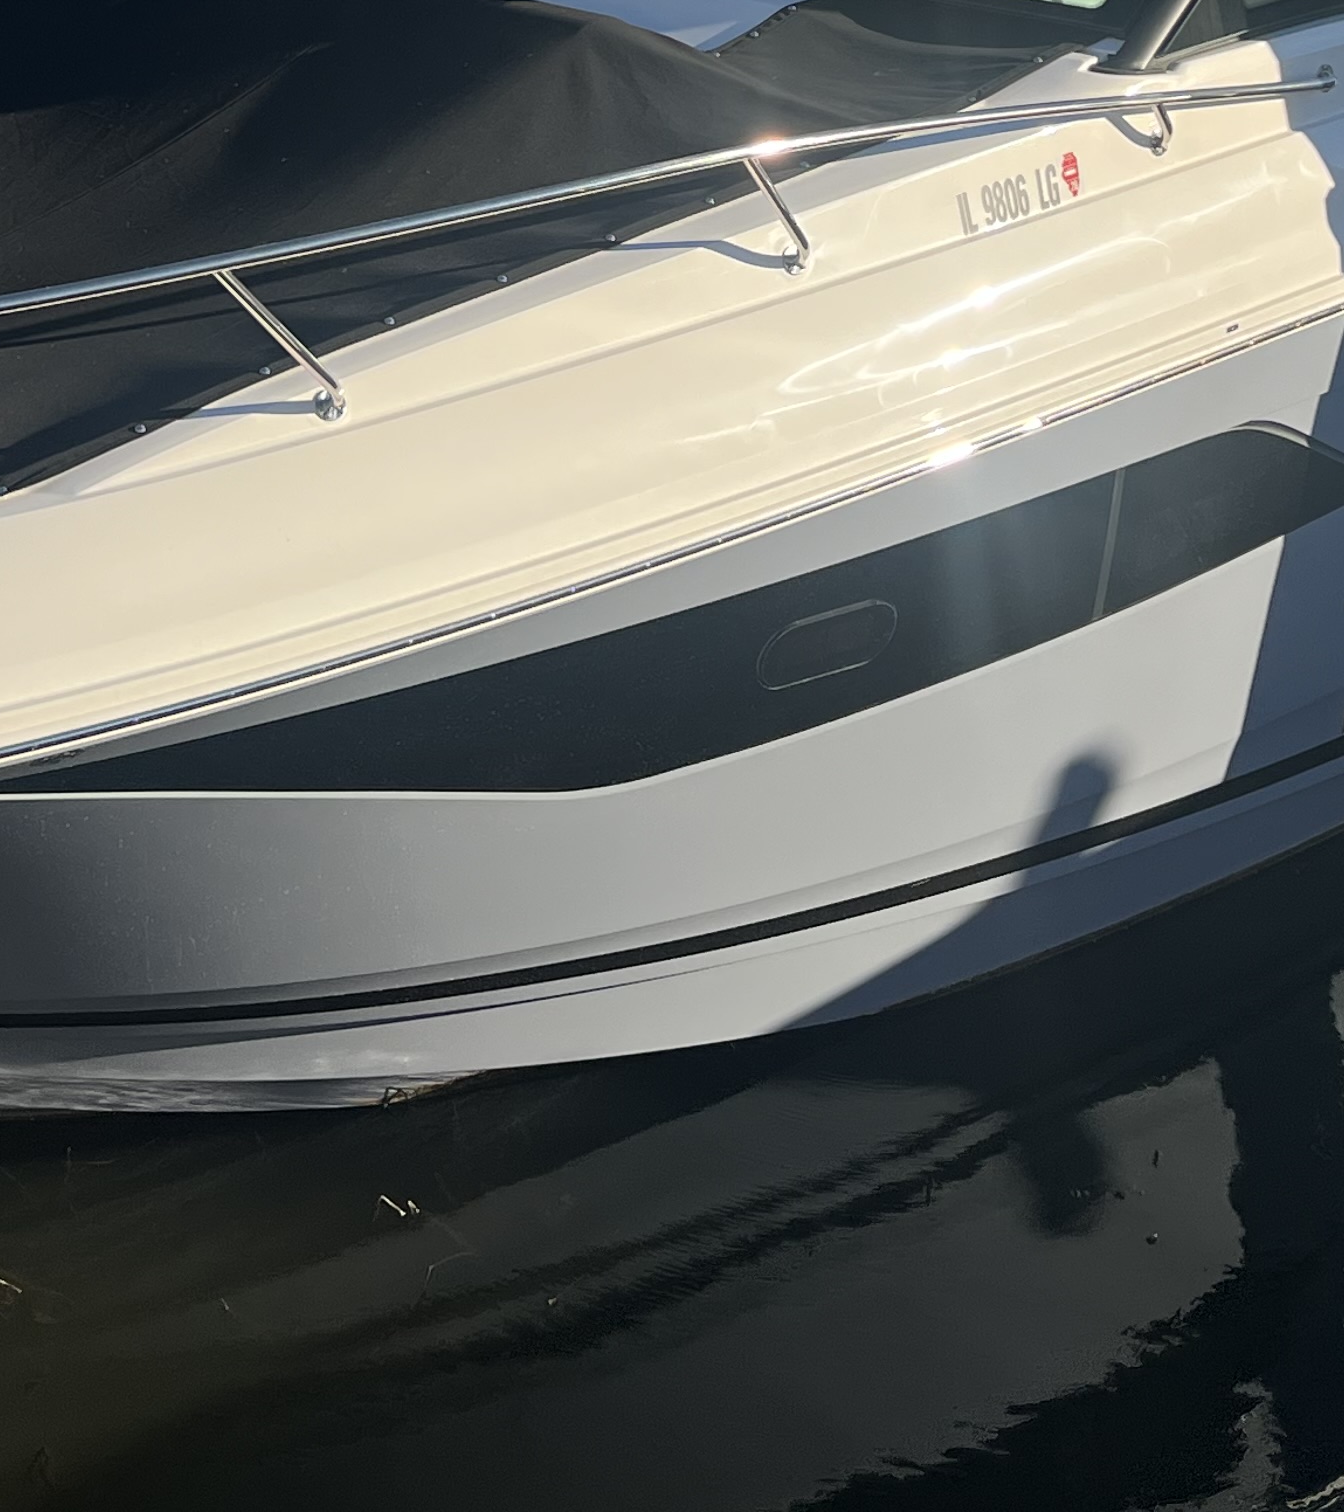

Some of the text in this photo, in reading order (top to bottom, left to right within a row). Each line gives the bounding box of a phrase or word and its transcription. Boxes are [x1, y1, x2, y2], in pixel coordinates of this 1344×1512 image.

[956, 192, 979, 236] IL
[981, 174, 1031, 226] 9806
[1035, 163, 1061, 211] LG
